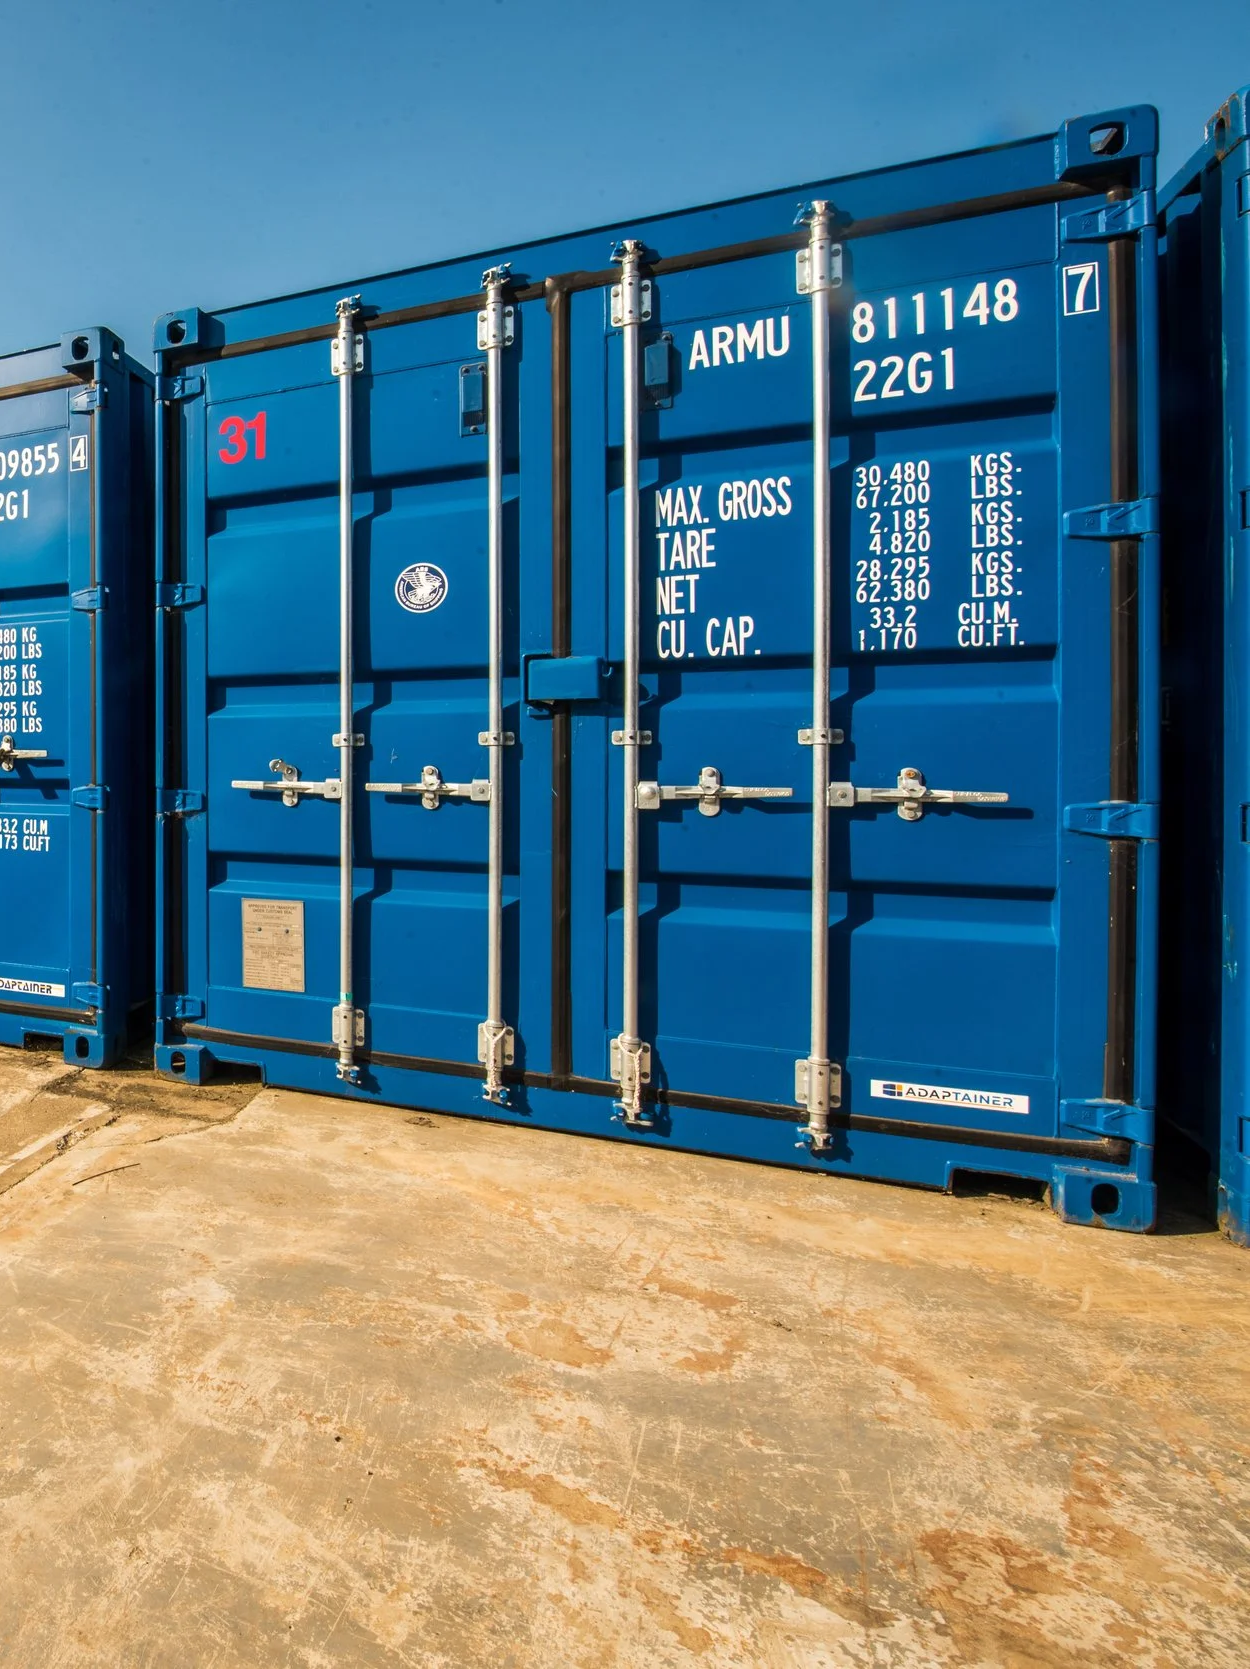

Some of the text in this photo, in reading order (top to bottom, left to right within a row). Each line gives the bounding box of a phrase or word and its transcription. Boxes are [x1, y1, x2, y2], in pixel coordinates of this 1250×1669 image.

[1068, 267, 1094, 313] 7
[689, 278, 1019, 370] ARMU 811148
[853, 347, 955, 402] 22G1
[219, 411, 266, 464] 31
[655, 485, 710, 528] MAX.
[718, 476, 792, 521] GROSS
[970, 451, 1022, 477] KGS.
[970, 474, 1023, 499] LBS.
[655, 528, 716, 571] TARE
[971, 501, 1023, 526] KGS.
[971, 523, 1023, 548] LBS.
[656, 574, 700, 616] NET
[971, 550, 1023, 575] KGS.
[971, 573, 1023, 598] LBS.
[22, 627, 37, 643] KG
[656, 600, 1018, 659] CU. CAP. 33.2 CU.M.
[957, 622, 1025, 648] CU.FT.
[22, 643, 43, 660] LBS
[22, 664, 37, 680] KG
[22, 680, 43, 697] LBS
[22, 701, 37, 717] KG
[22, 717, 43, 733] LBS
[905, 1086, 1014, 1108] ADAPTAINER
